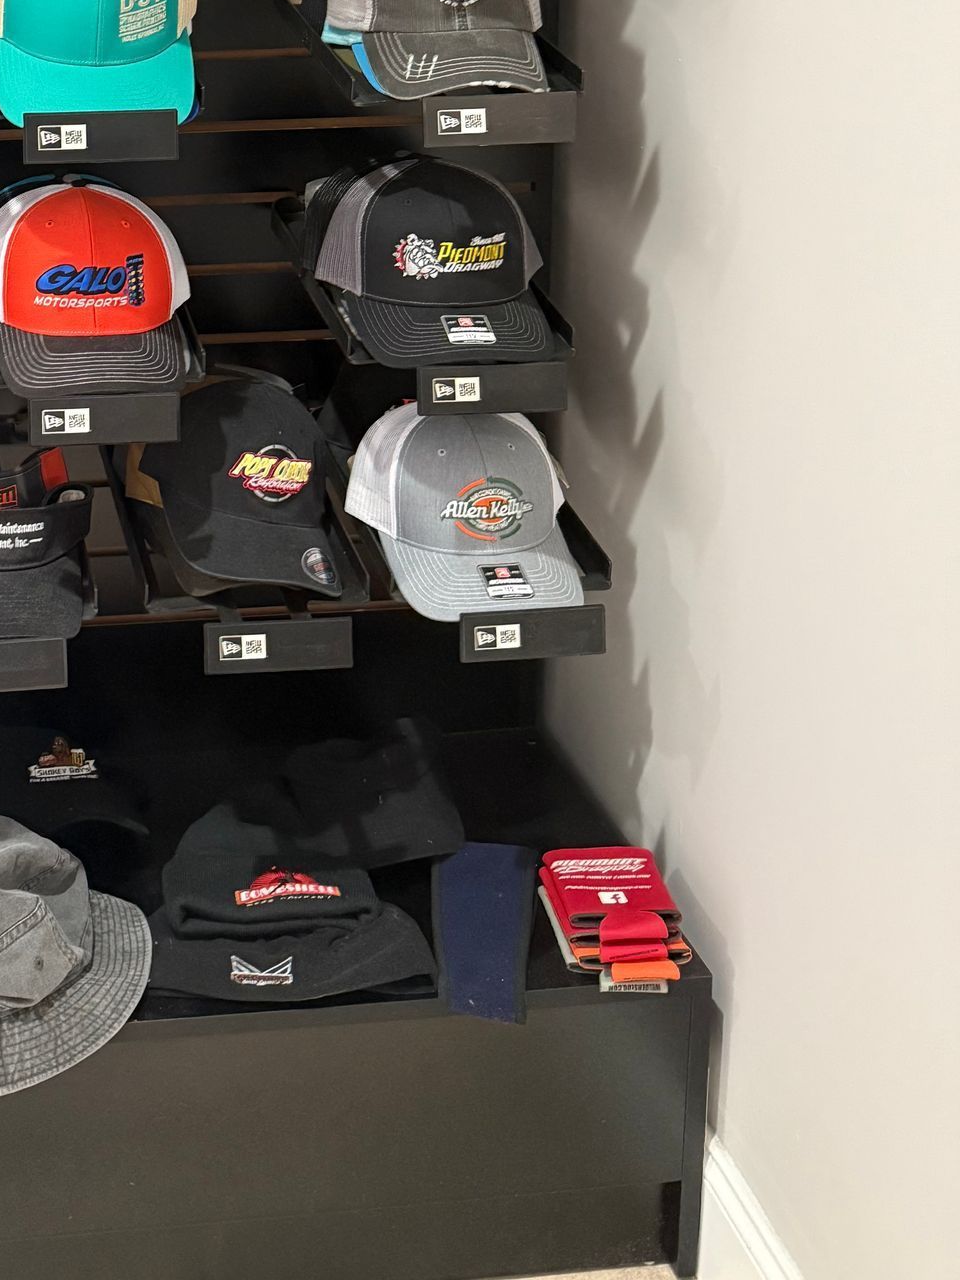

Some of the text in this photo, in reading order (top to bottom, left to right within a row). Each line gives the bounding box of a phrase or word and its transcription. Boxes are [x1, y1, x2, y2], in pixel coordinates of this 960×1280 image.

[462, 113, 483, 121] NEW
[462, 121, 483, 129] ERA
[62, 129, 83, 137] NEW
[62, 137, 83, 145] ERA
[437, 241, 507, 263] PIEDMONT
[443, 258, 505, 273] DRAGWAY
[34, 295, 128, 309] MOTORSPORTS
[440, 500, 489, 521] Allen
